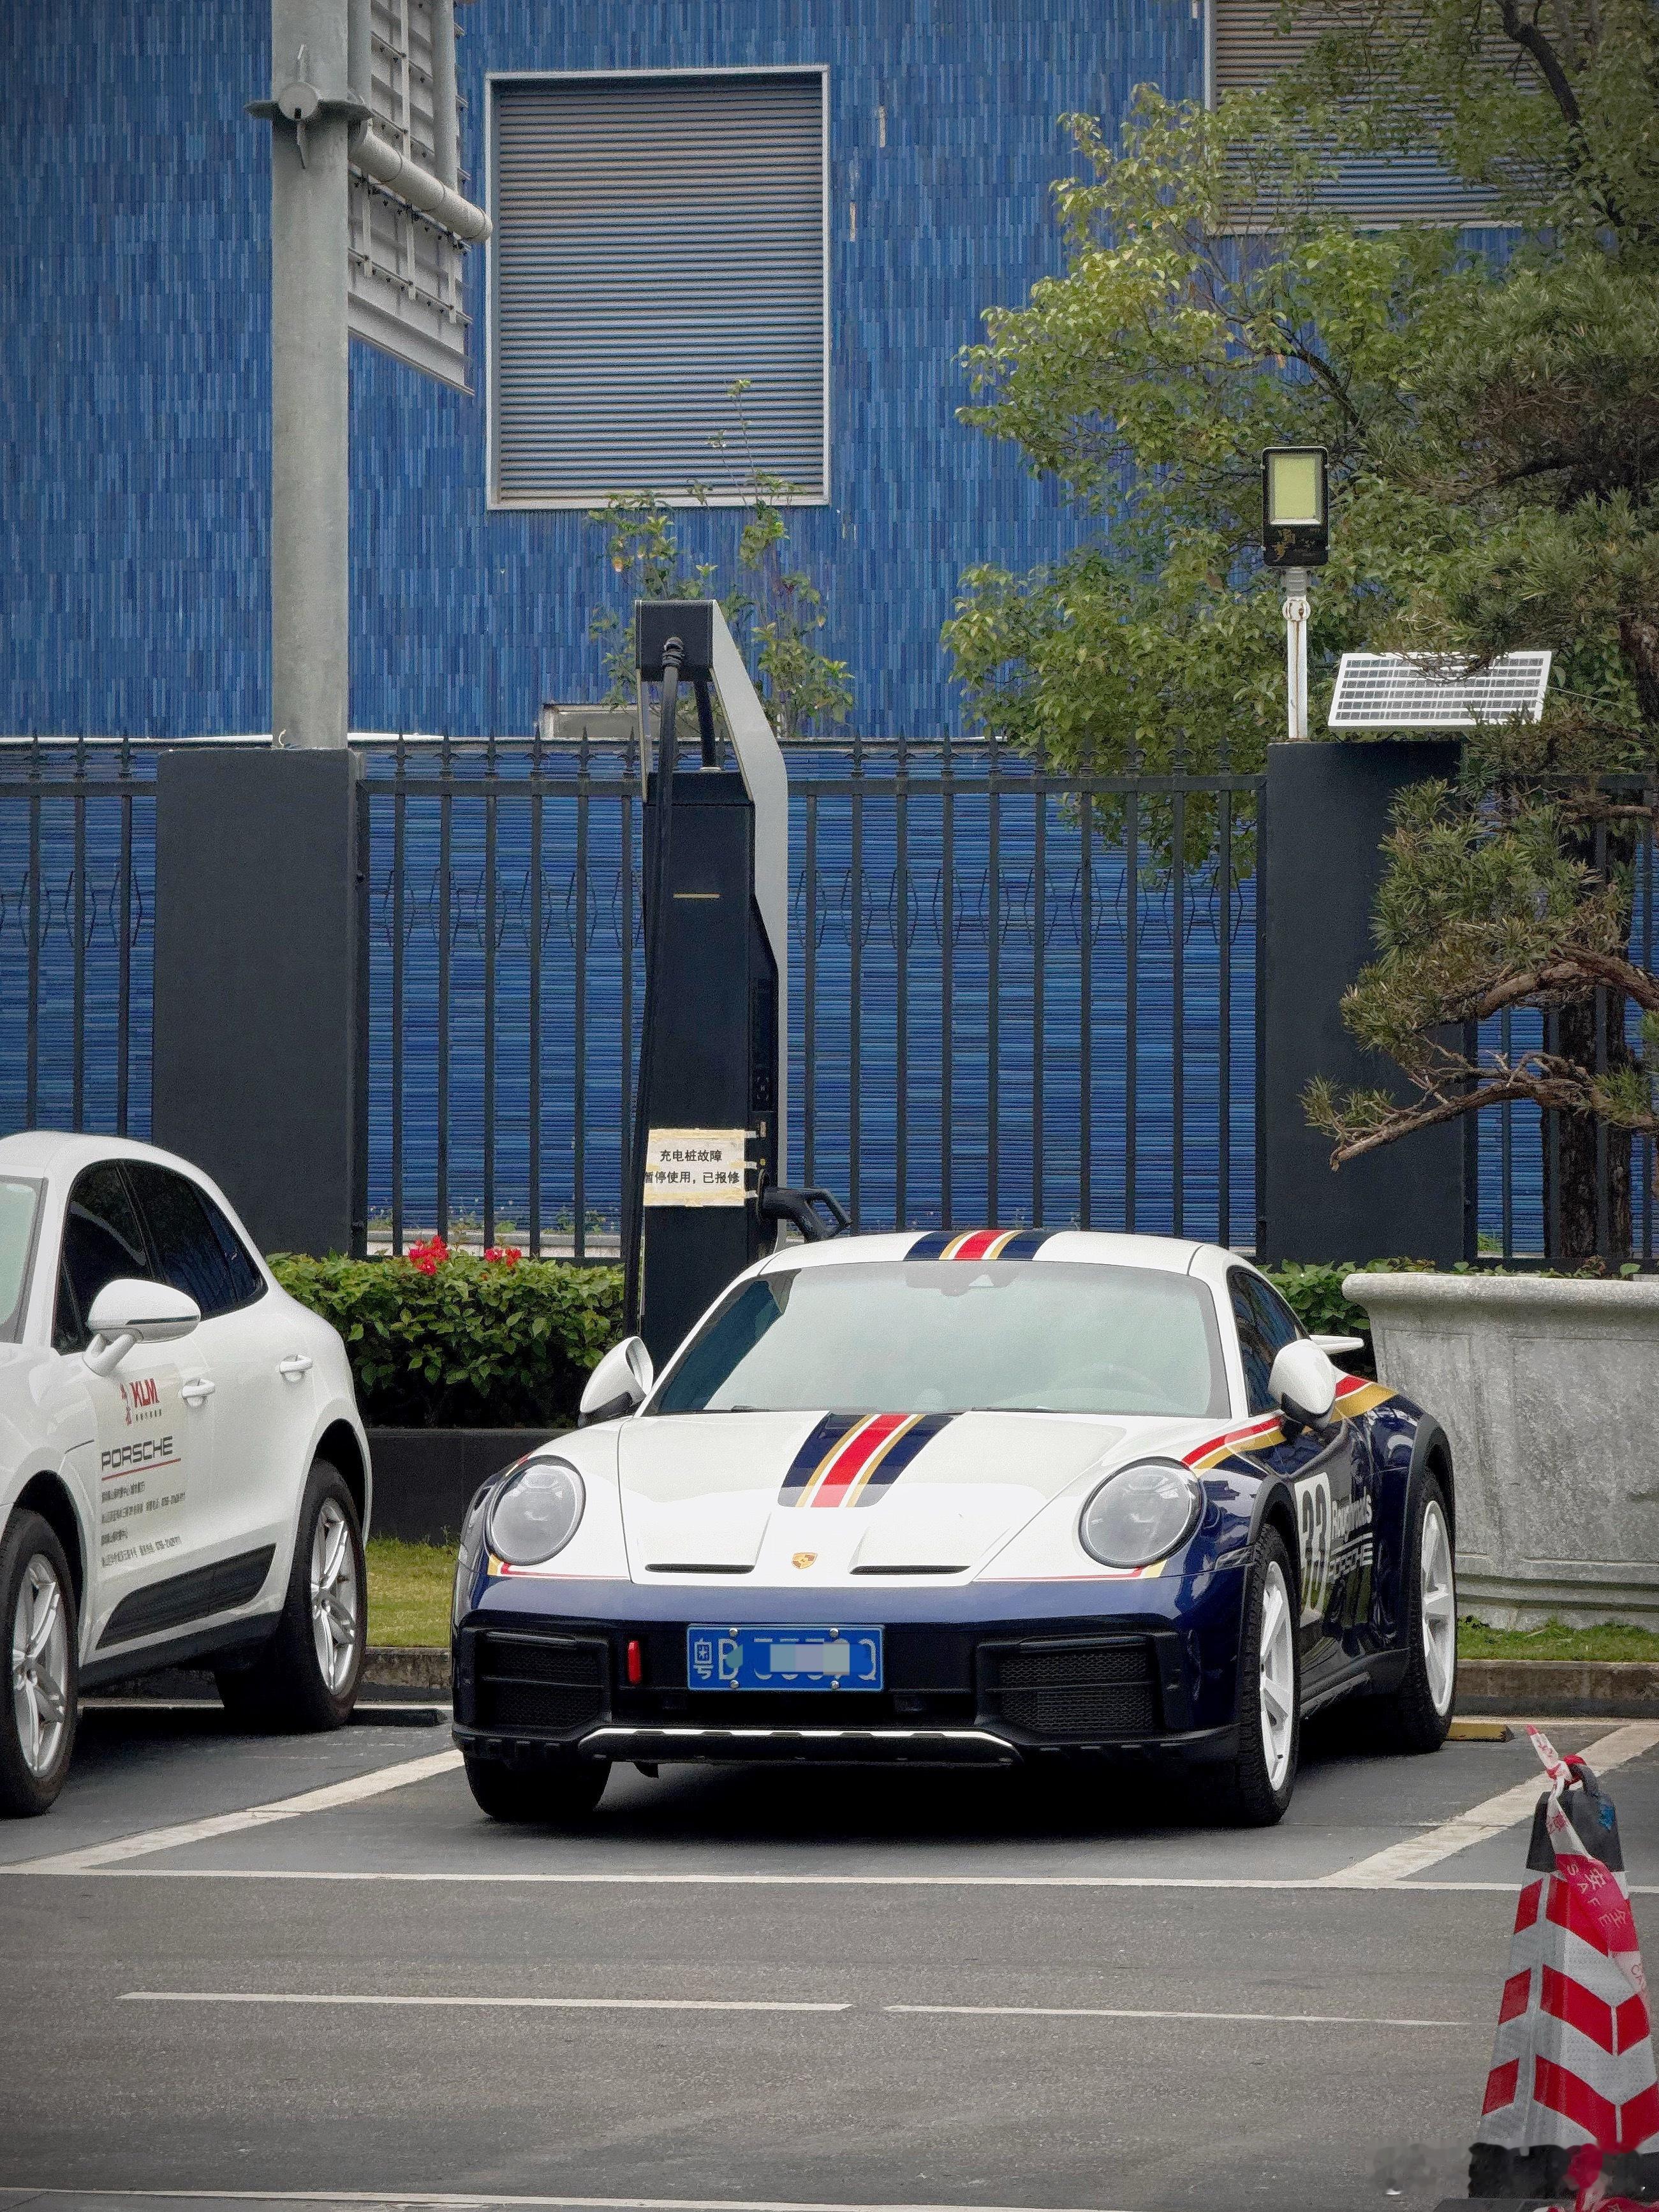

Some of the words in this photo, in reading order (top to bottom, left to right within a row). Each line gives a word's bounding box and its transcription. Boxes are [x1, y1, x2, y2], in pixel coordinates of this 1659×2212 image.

[660, 1149, 723, 1162] 充电桩故障
[101, 1436, 173, 1471] PORSCHE
[1567, 1863, 1612, 1928] SAFE
